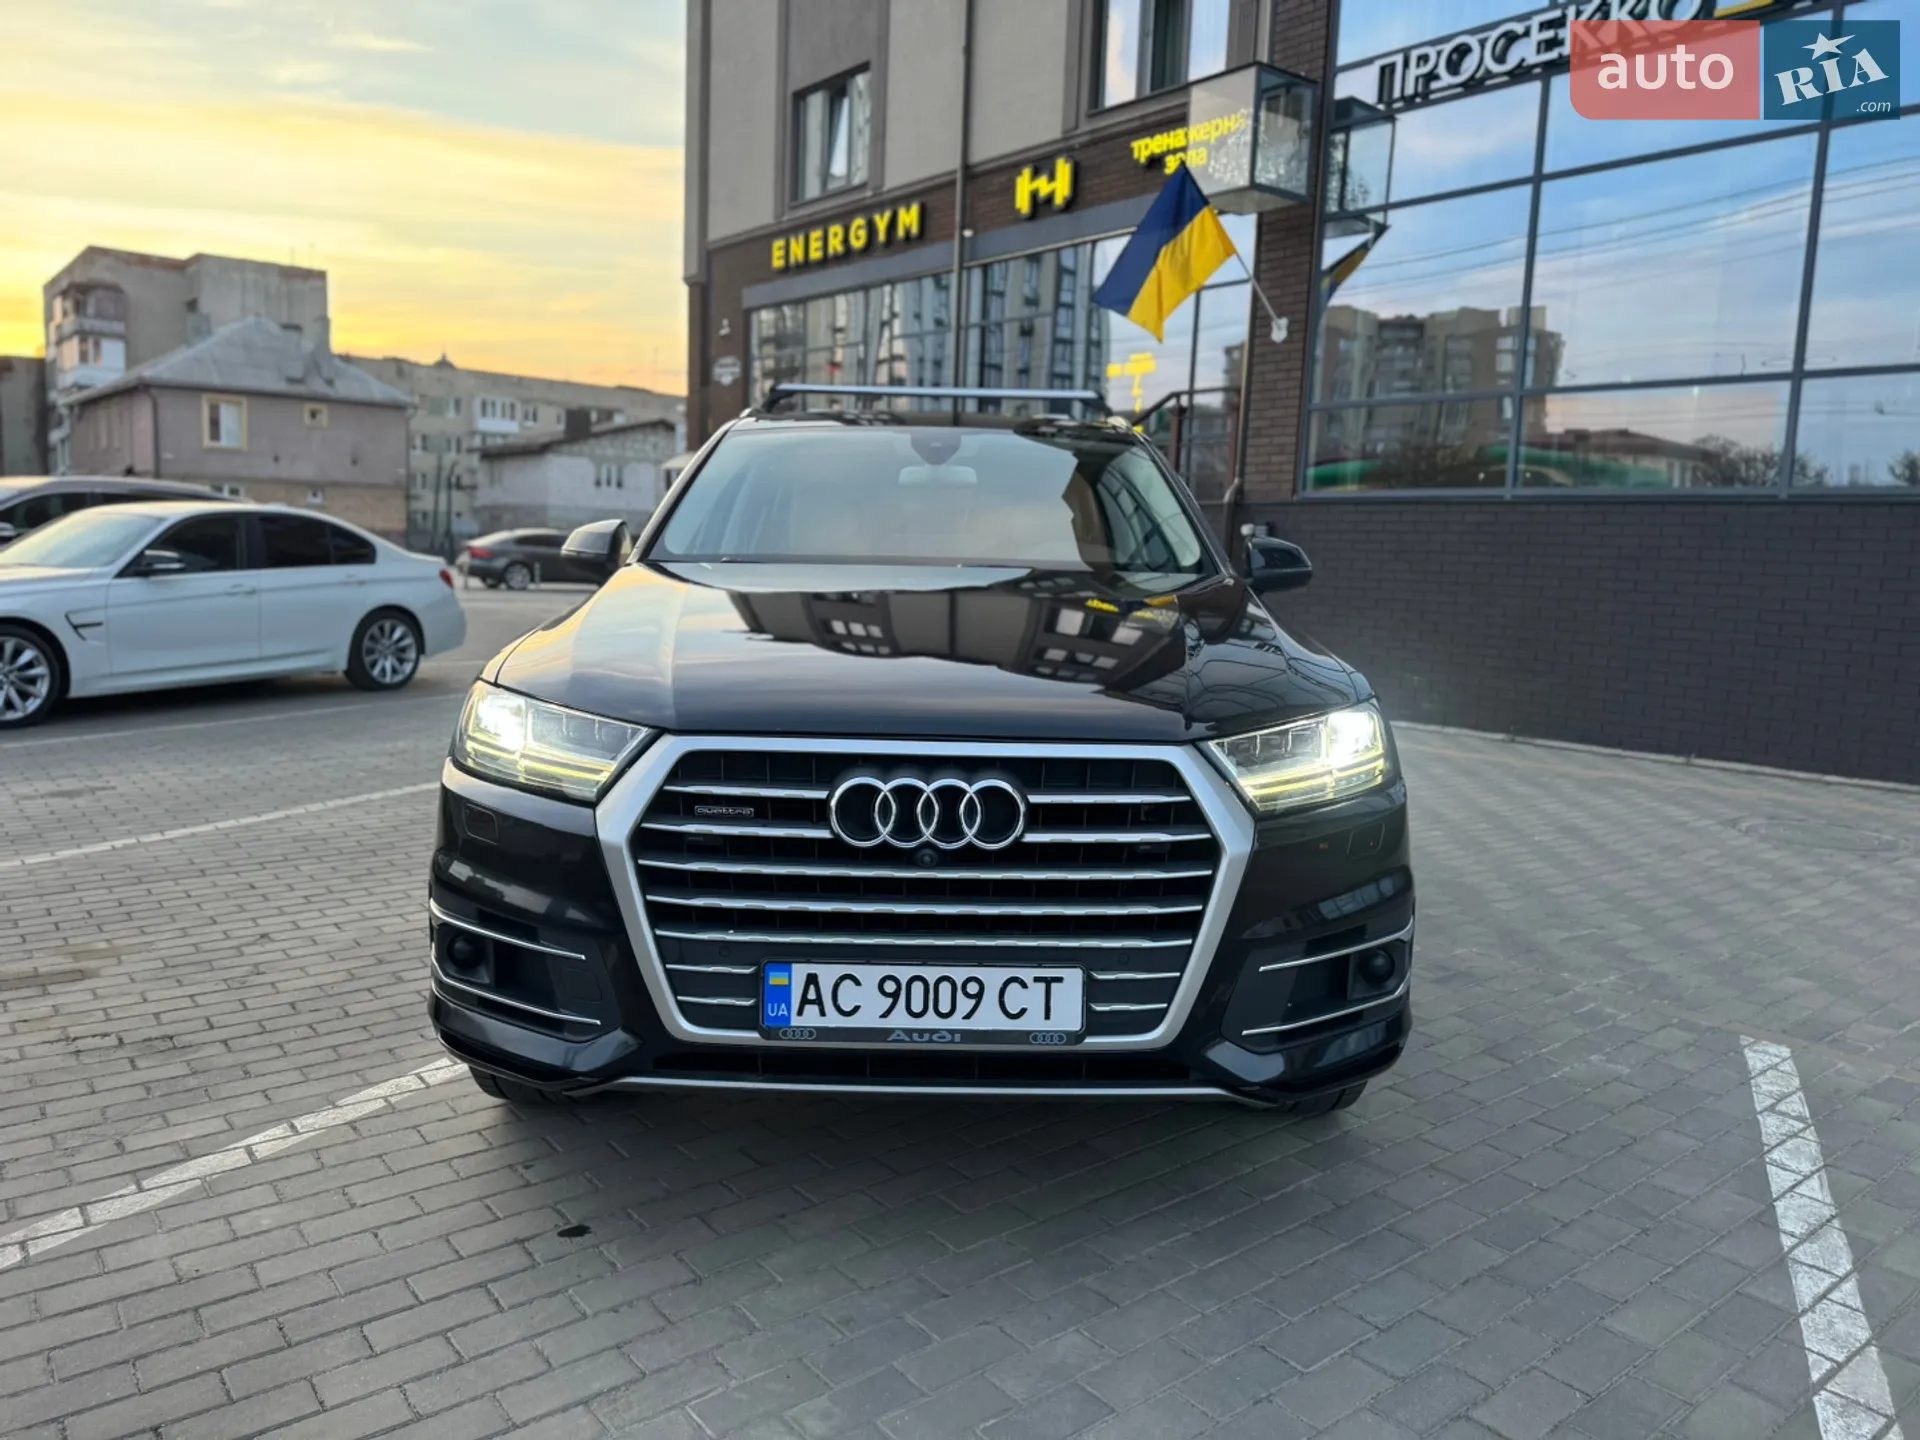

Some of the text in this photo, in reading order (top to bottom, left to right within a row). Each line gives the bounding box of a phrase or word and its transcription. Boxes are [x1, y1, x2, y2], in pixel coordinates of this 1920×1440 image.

[771, 202, 920, 270] ENERGYM
[768, 1002, 788, 1017] UA
[796, 972, 1064, 1021] AC 9009 CT
[886, 1029, 961, 1043] Audi
